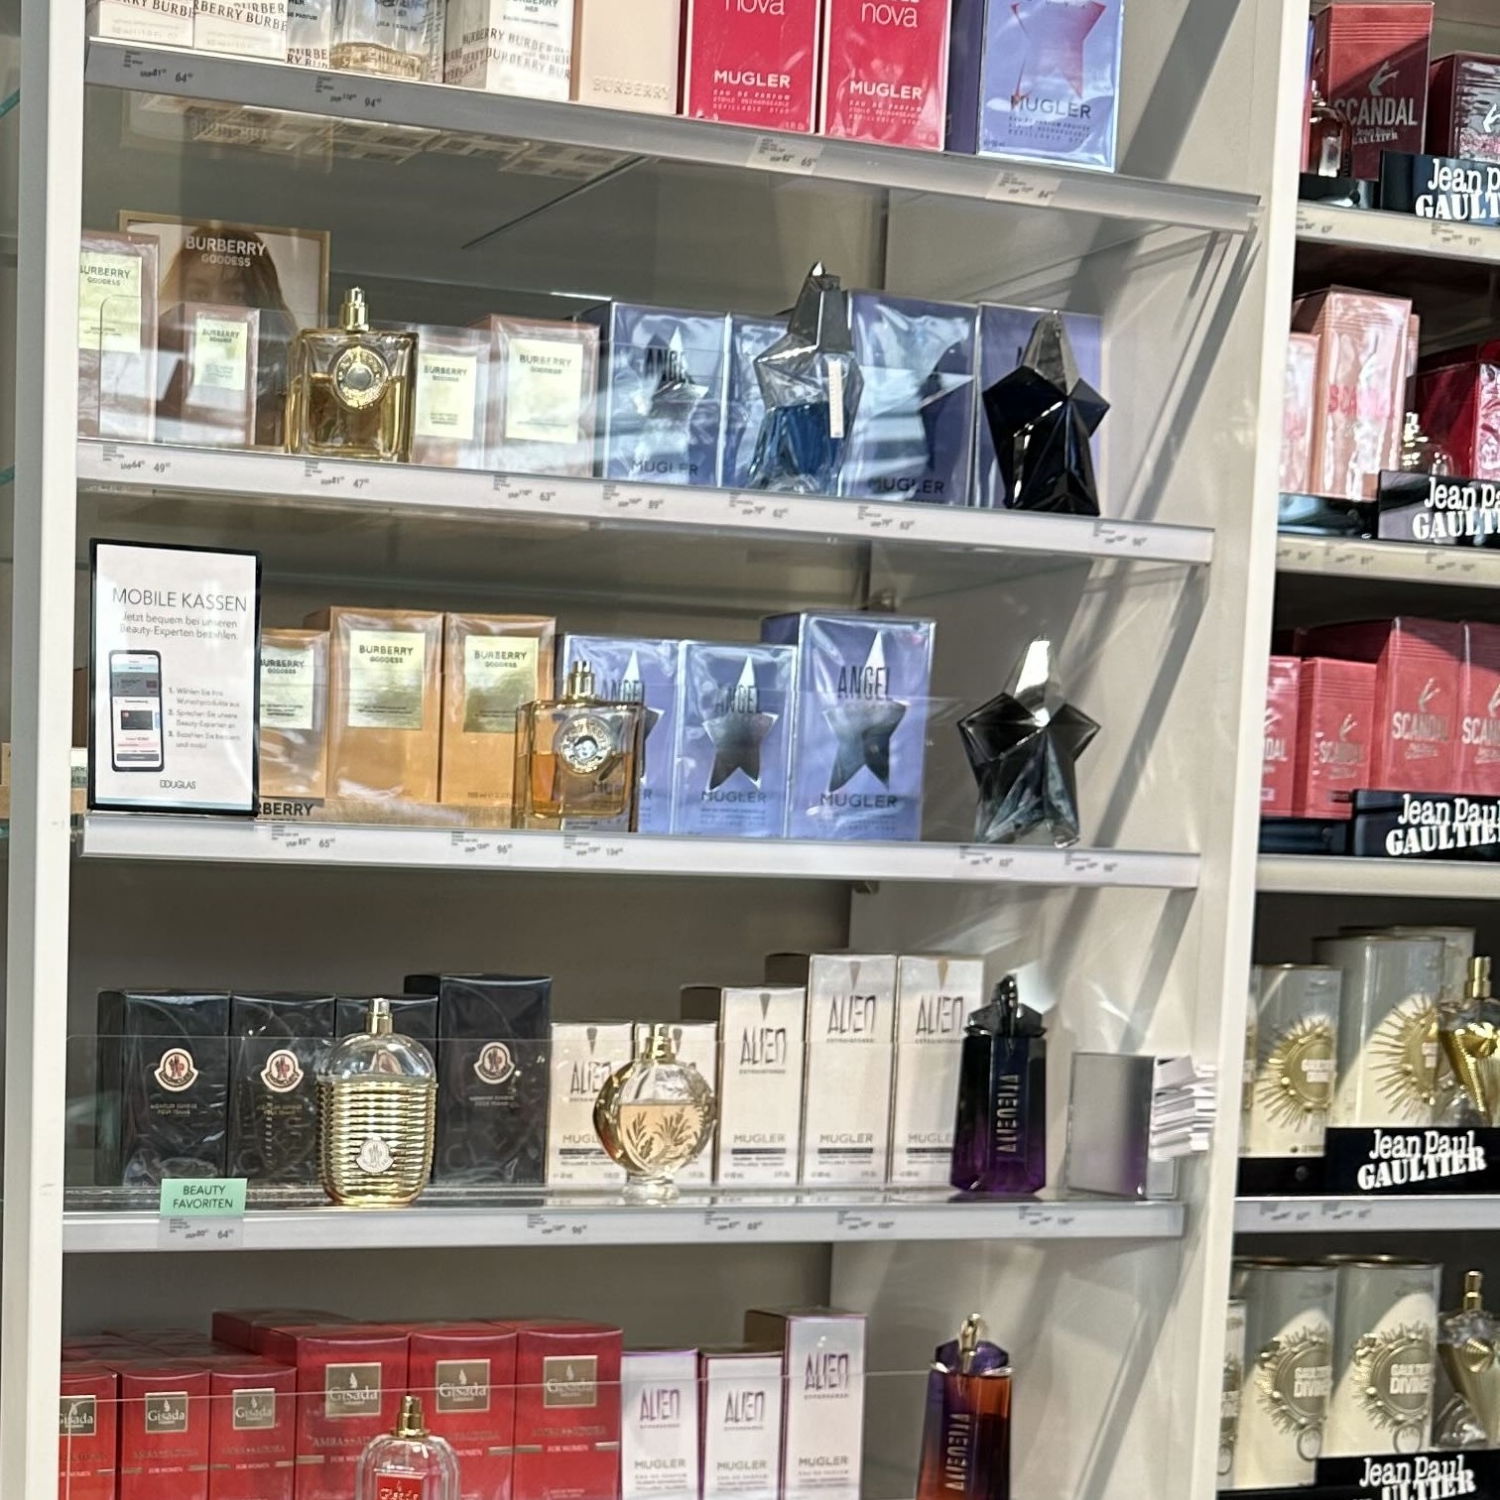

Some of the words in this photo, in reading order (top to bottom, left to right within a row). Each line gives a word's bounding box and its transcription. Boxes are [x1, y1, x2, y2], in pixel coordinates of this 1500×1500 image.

[860, 2, 918, 28] nova
[713, 69, 791, 89] MUGLER
[592, 76, 673, 101] BURBERRY
[849, 79, 923, 100] MUGLER
[1010, 95, 1092, 120] MUGLER
[1333, 97, 1419, 127] SCANDAL
[1427, 158, 1482, 194] Jean
[184, 235, 267, 256] BURBERRY
[201, 253, 251, 268] GODDESS
[202, 327, 240, 339] BURBERRY
[519, 353, 572, 368] BURBERRY
[423, 364, 467, 377] BURBERRY
[632, 459, 699, 476] MUGLER
[867, 476, 945, 495] MUGLER
[1424, 476, 1477, 511] Jean
[112, 588, 177, 608] MOBILE
[181, 592, 247, 612] KASSEN
[122, 612, 144, 622] Jetzt
[146, 613, 183, 627] bequem
[201, 616, 237, 628] uneren
[197, 627, 238, 641] bezhlen.
[359, 644, 414, 656] BURBERRY
[474, 650, 527, 661] BURBERRY
[836, 665, 893, 701] ANGEL
[714, 684, 762, 715] ANGEL
[1391, 711, 1449, 743] SCANDAL
[159, 779, 197, 790] DOUGLAS
[701, 789, 767, 805] MUGLER
[819, 792, 899, 809] MUGLER
[1398, 794, 1451, 826] Jean
[827, 994, 877, 1035] ALIEN
[915, 994, 964, 1035] ALIEN
[740, 1027, 787, 1066] ALIEN
[562, 1133, 600, 1144] MUGL
[733, 1133, 786, 1145] MUGLER
[819, 1133, 874, 1145] MUGLER
[1369, 1129, 1426, 1160] Jean
[1425, 1130, 1477, 1158] Paul
[1357, 1146, 1488, 1191] GAULTIER
[182, 1184, 226, 1197] BEAUTY
[172, 1197, 234, 1210] FAVORITEN
[804, 1352, 850, 1391] ALIEN
[328, 1384, 379, 1402] Gisada
[439, 1382, 487, 1399] Gisada
[546, 1378, 594, 1394] Gisada
[235, 1405, 272, 1419] Gisada
[639, 1388, 681, 1422] ALIEN
[724, 1390, 766, 1424] ALIEN
[148, 1408, 186, 1421] Gisada
[634, 1458, 687, 1471] MUGLER
[717, 1460, 768, 1471] MUGLER
[798, 1455, 849, 1468] MUGLER
[1359, 1458, 1412, 1488] Jean
[1414, 1454, 1466, 1484] Paul
